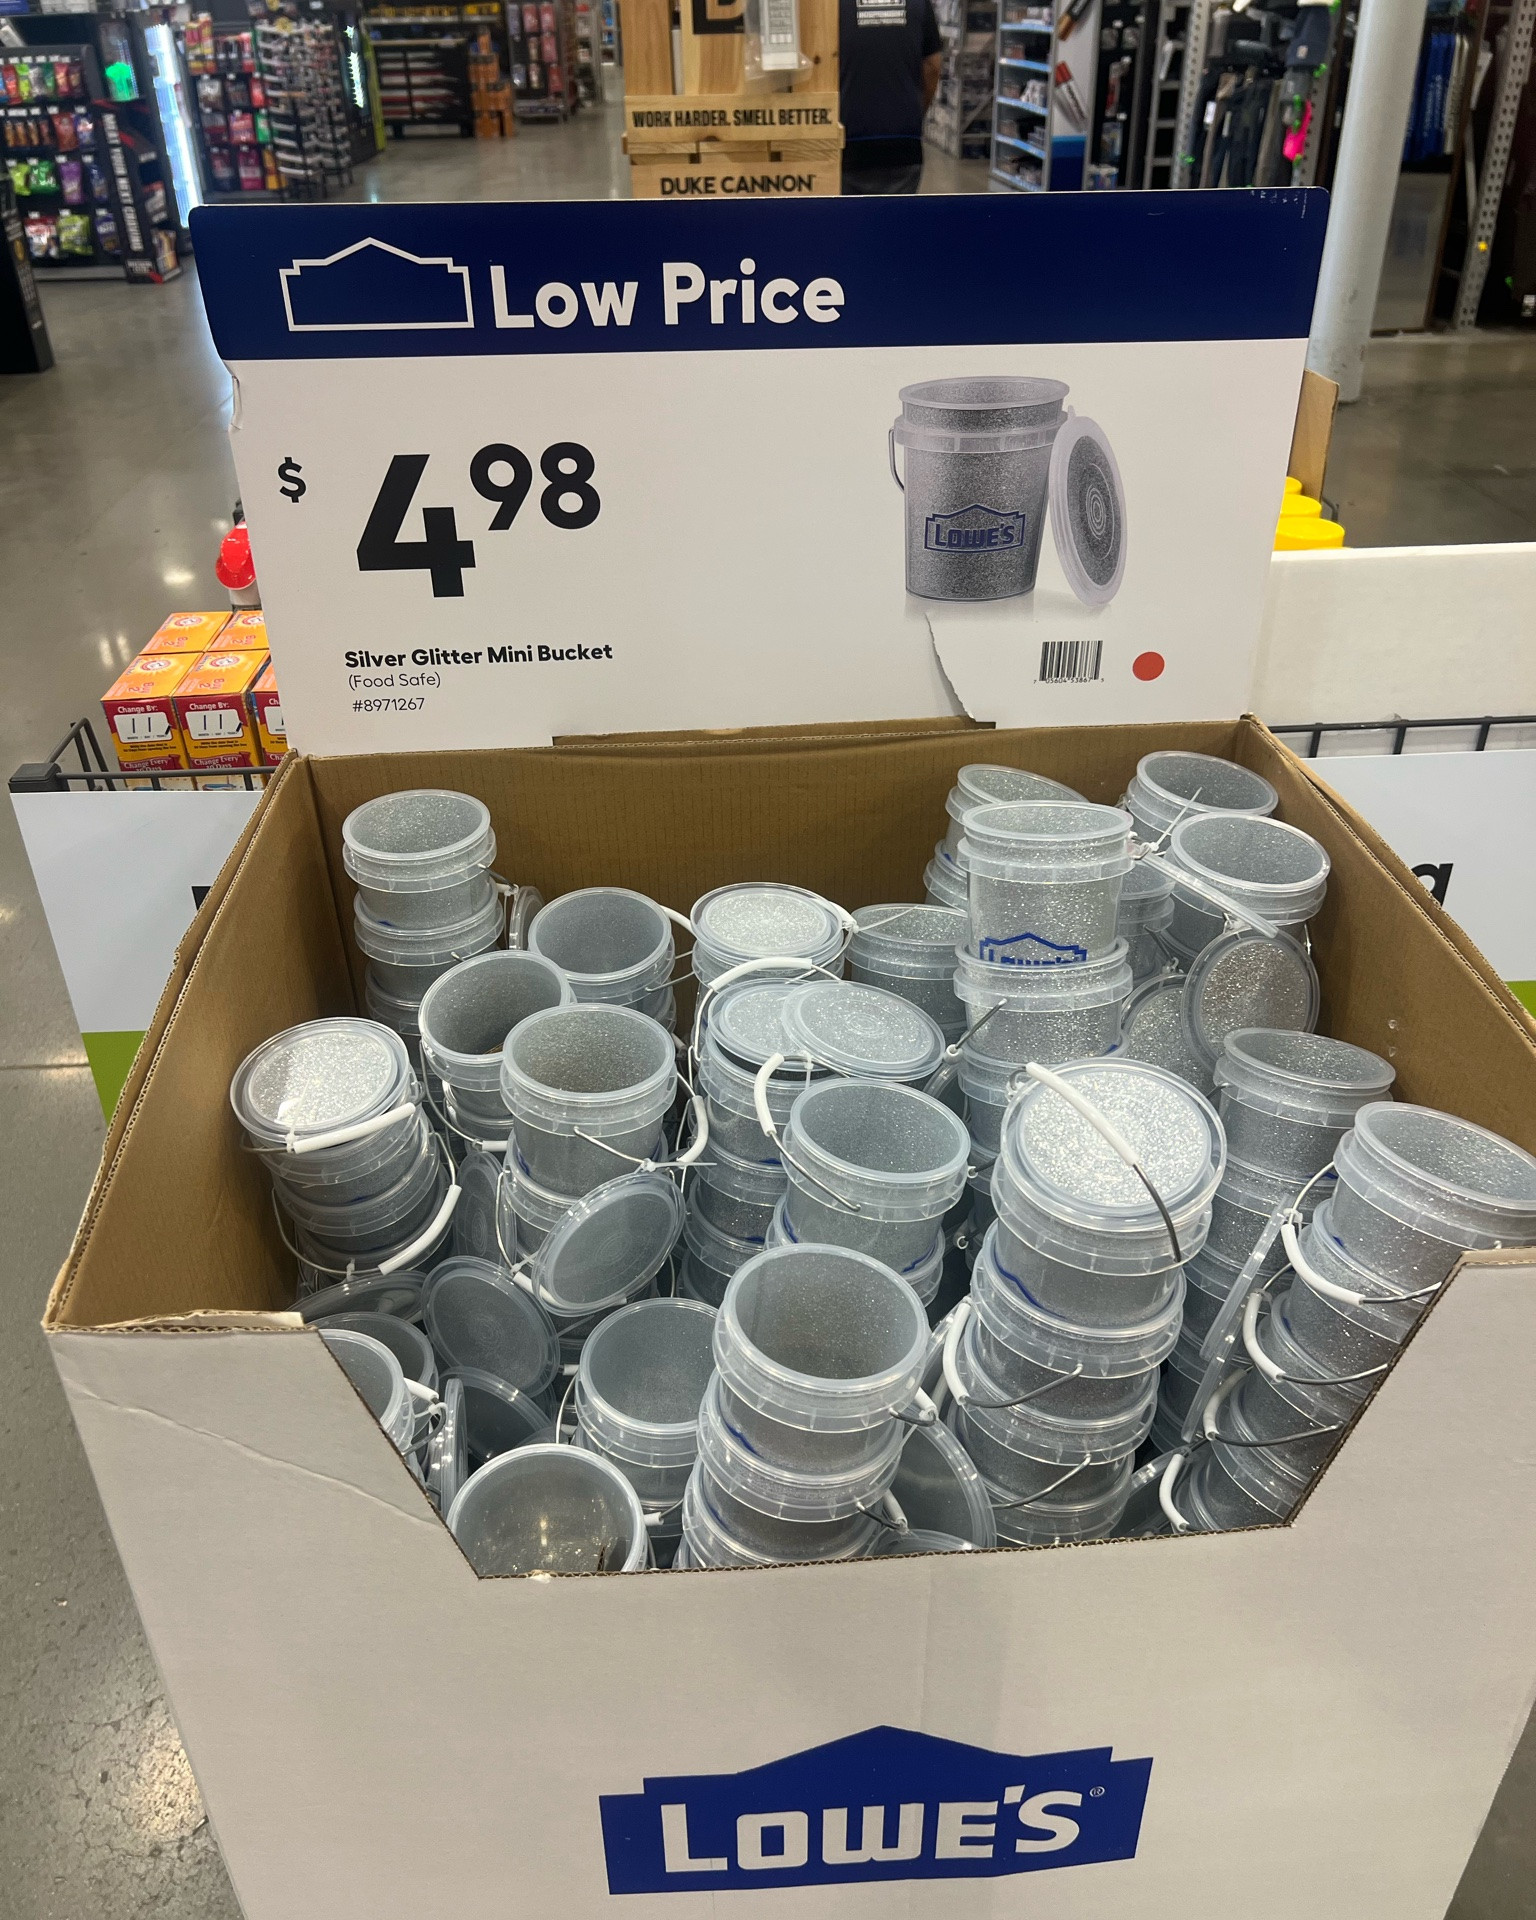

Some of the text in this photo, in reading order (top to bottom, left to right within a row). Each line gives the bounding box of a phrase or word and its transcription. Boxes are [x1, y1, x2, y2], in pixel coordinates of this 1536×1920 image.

[632, 108, 832, 127] WORK HARDER. SMELL BETTER.
[660, 174, 814, 195] DUKE CANNON
[490, 258, 845, 328] Low Price
[935, 523, 1015, 548] LOWE'S
[344, 643, 613, 668] Silver Glitter Mini Bucket
[348, 671, 441, 691] (Food Safe)
[117, 706, 145, 714] Change
[189, 703, 216, 711] Change
[352, 697, 425, 712] #8971267
[220, 755, 238, 763] Every
[660, 1783, 1082, 1873] LOWE'S
